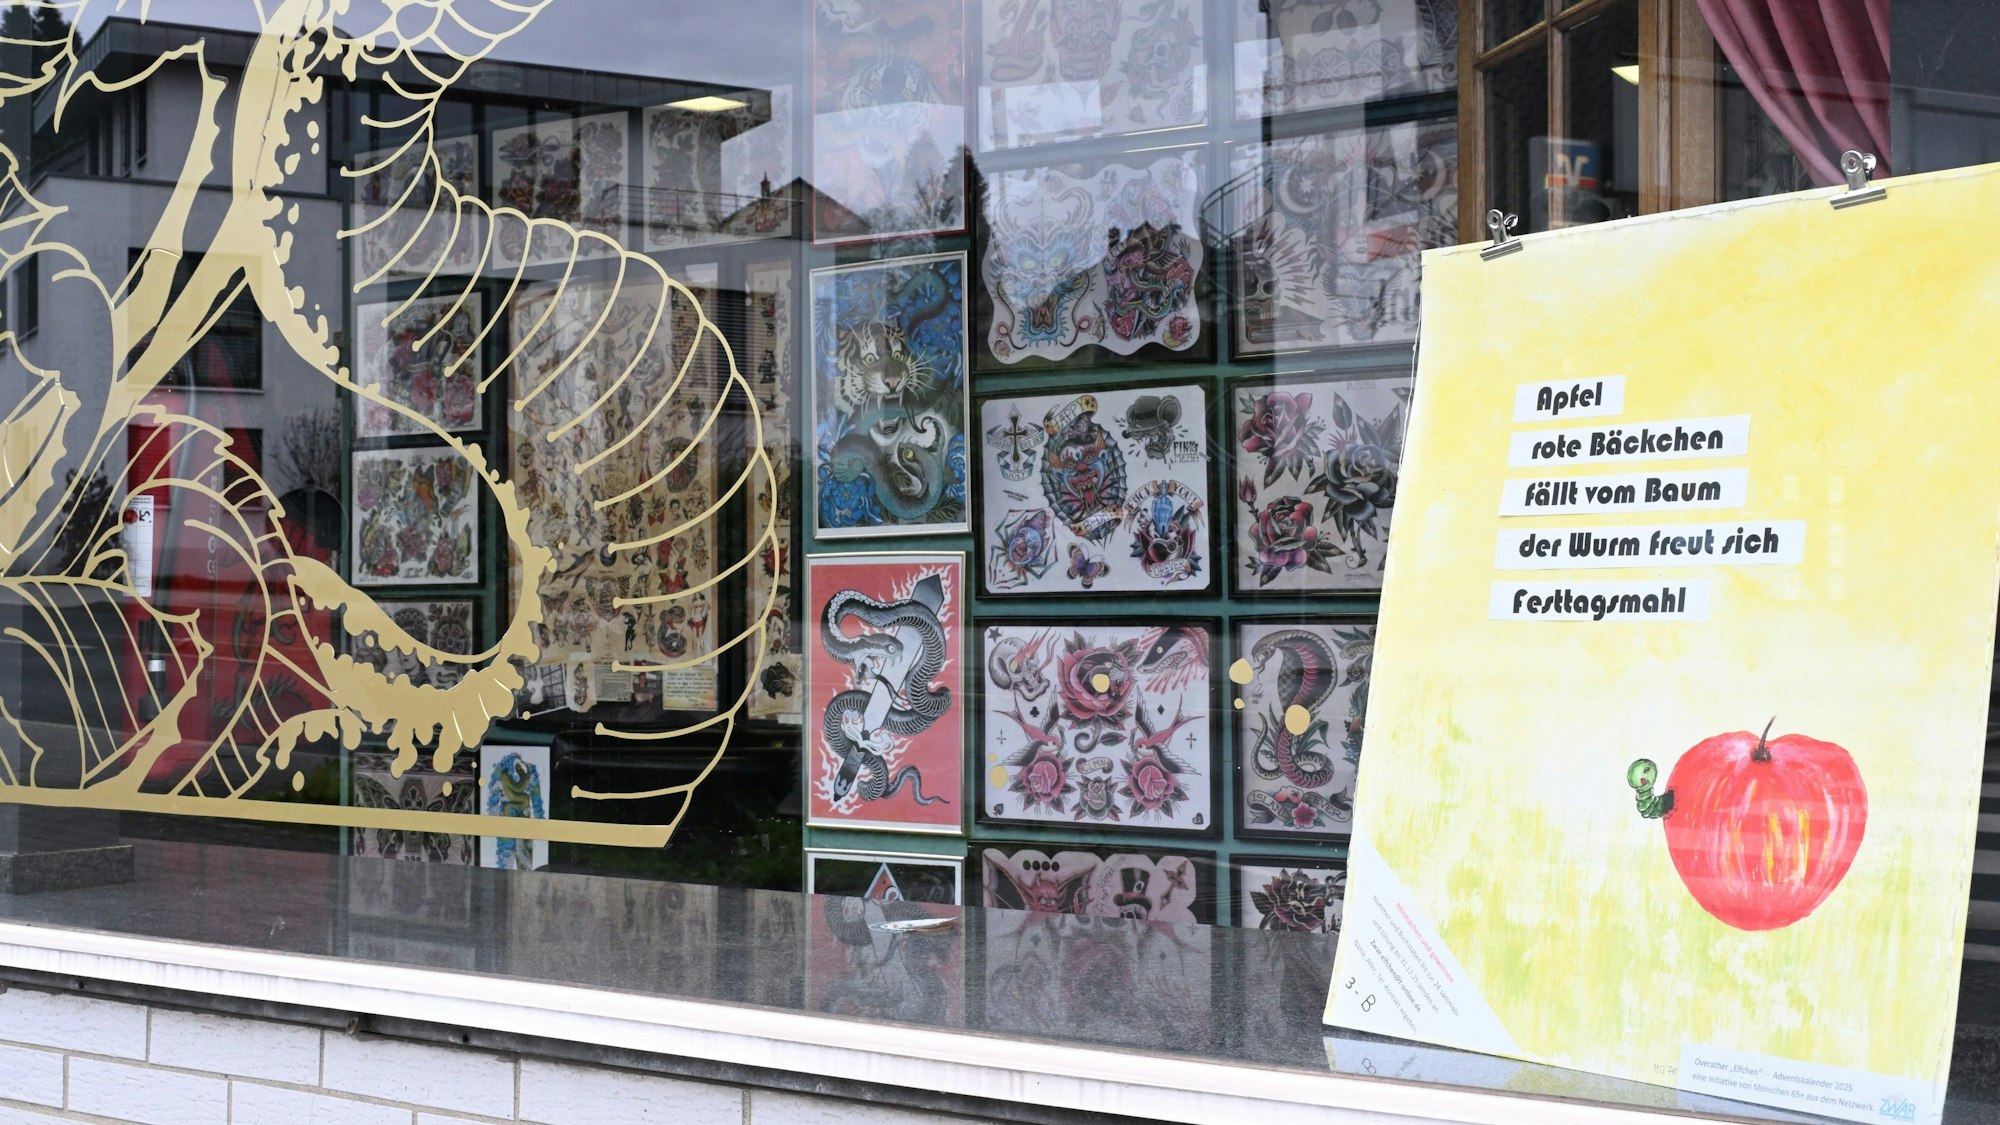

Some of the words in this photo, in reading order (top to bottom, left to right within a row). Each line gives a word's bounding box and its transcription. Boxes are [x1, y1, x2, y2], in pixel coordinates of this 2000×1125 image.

[1536, 382, 1602, 415] Apfel
[1531, 435, 1582, 459] rote
[1589, 426, 1723, 456] Bäckchen
[1524, 481, 1578, 506] fällt
[1585, 484, 1635, 504] vom
[1644, 477, 1721, 502] Baum
[1519, 533, 1561, 557] der
[1568, 532, 1640, 557] Wurm
[1649, 529, 1714, 555] freut
[1721, 527, 1779, 554] sich
[1150, 560, 1185, 577] FOREVER
[1512, 587, 1686, 621] Festtagsmahl
[1252, 794, 1289, 819] ISLAND
[1308, 793, 1345, 819] FEVER
[1373, 896, 1391, 920] Nummer
[1389, 919, 1400, 932] und
[1398, 931, 1422, 963] Buchstaben
[1396, 903, 1423, 939] Mitmachen
[1421, 938, 1433, 952] und
[1430, 952, 1454, 983] gewinnen
[1372, 919, 1382, 931] und
[1417, 983, 1433, 1004] senden
[1345, 977, 1356, 989] 3
[1361, 994, 1376, 1013] B
[1694, 1057, 1729, 1071] Overather
[1772, 1071, 1833, 1089] Adventskalender
[1835, 1081, 1853, 1092] 2025
[1692, 1071, 1707, 1081] eine
[1708, 1074, 1737, 1087] Initiative
[1739, 1081, 1752, 1090] von
[1753, 1081, 1790, 1097] Menschen
[1806, 1093, 1819, 1102] aus
[1820, 1094, 1837, 1105] dem
[1838, 1097, 1874, 1112] Netzwerk
[1879, 1097, 1916, 1120] ZWAR
